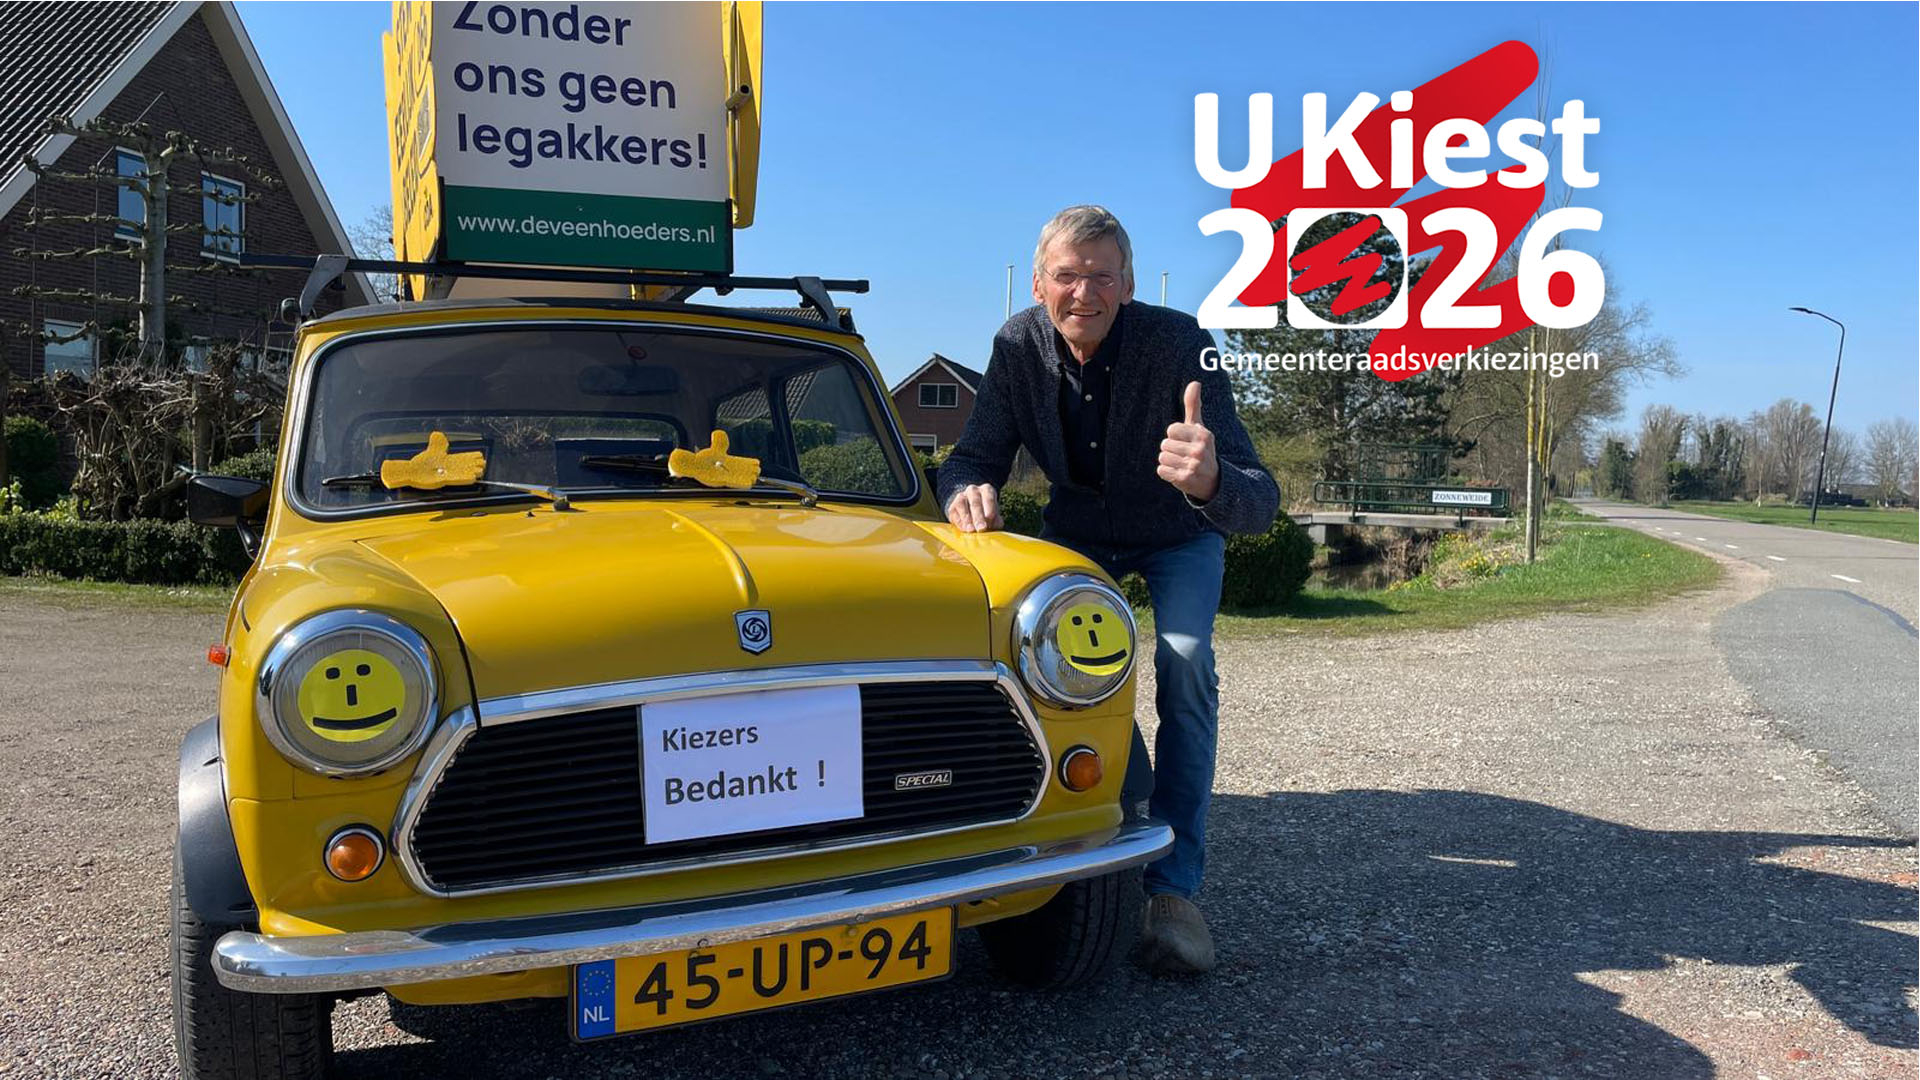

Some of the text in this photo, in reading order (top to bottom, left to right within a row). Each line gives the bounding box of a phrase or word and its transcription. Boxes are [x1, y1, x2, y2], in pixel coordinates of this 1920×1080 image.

[453, 0, 631, 46] Zonder
[453, 61, 676, 112] ons geen
[457, 113, 708, 169] legakkers!
[457, 213, 716, 244] www.deveenhoeders.nl
[1434, 493, 1490, 502] ZONNEWEIDE
[661, 726, 759, 752] Kiezers
[664, 760, 826, 805] Bedankt !
[898, 773, 950, 787] SPECIAL
[634, 921, 931, 1016] 45-UP-94
[583, 1006, 610, 1024] NL
